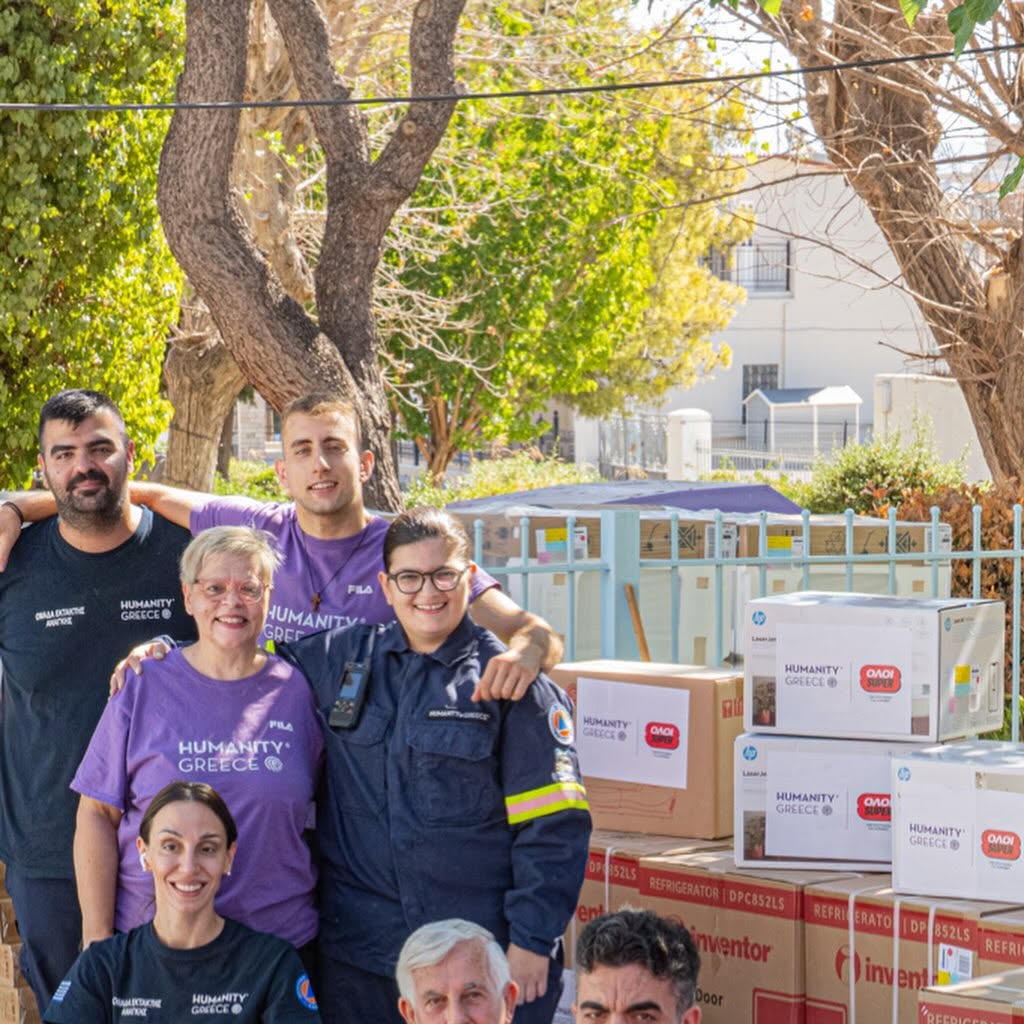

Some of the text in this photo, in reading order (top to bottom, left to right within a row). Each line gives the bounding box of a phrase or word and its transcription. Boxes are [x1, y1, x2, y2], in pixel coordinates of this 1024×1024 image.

[347, 584, 373, 595] FILA
[120, 598, 173, 610] HUMANITY
[120, 609, 160, 622] GREECE
[263, 624, 305, 643] GREE
[785, 664, 840, 675] HUMANITY
[785, 676, 825, 687] GREECE
[866, 677, 894, 689] SUPER
[269, 720, 294, 732] FILA
[583, 717, 629, 730] HUMANITY
[583, 727, 616, 741] GREECE
[178, 740, 283, 755] HUMANITY
[178, 755, 260, 773] GREECE
[776, 791, 835, 803] HUMANITY
[864, 797, 891, 807] ΟΛΟ
[776, 803, 819, 816] GREECE
[863, 806, 891, 817] SUPE
[909, 823, 962, 837] HUMANITY
[909, 835, 947, 850] GREECE
[649, 877, 785, 911] REFRIGERATOR DPC852LS
[813, 903, 971, 942] REFRIERATO DP852LS
[690, 926, 771, 963] inventor
[865, 956, 938, 991] invent
[192, 993, 247, 1005] HUMANITY
[191, 1004, 229, 1015] GREECE
